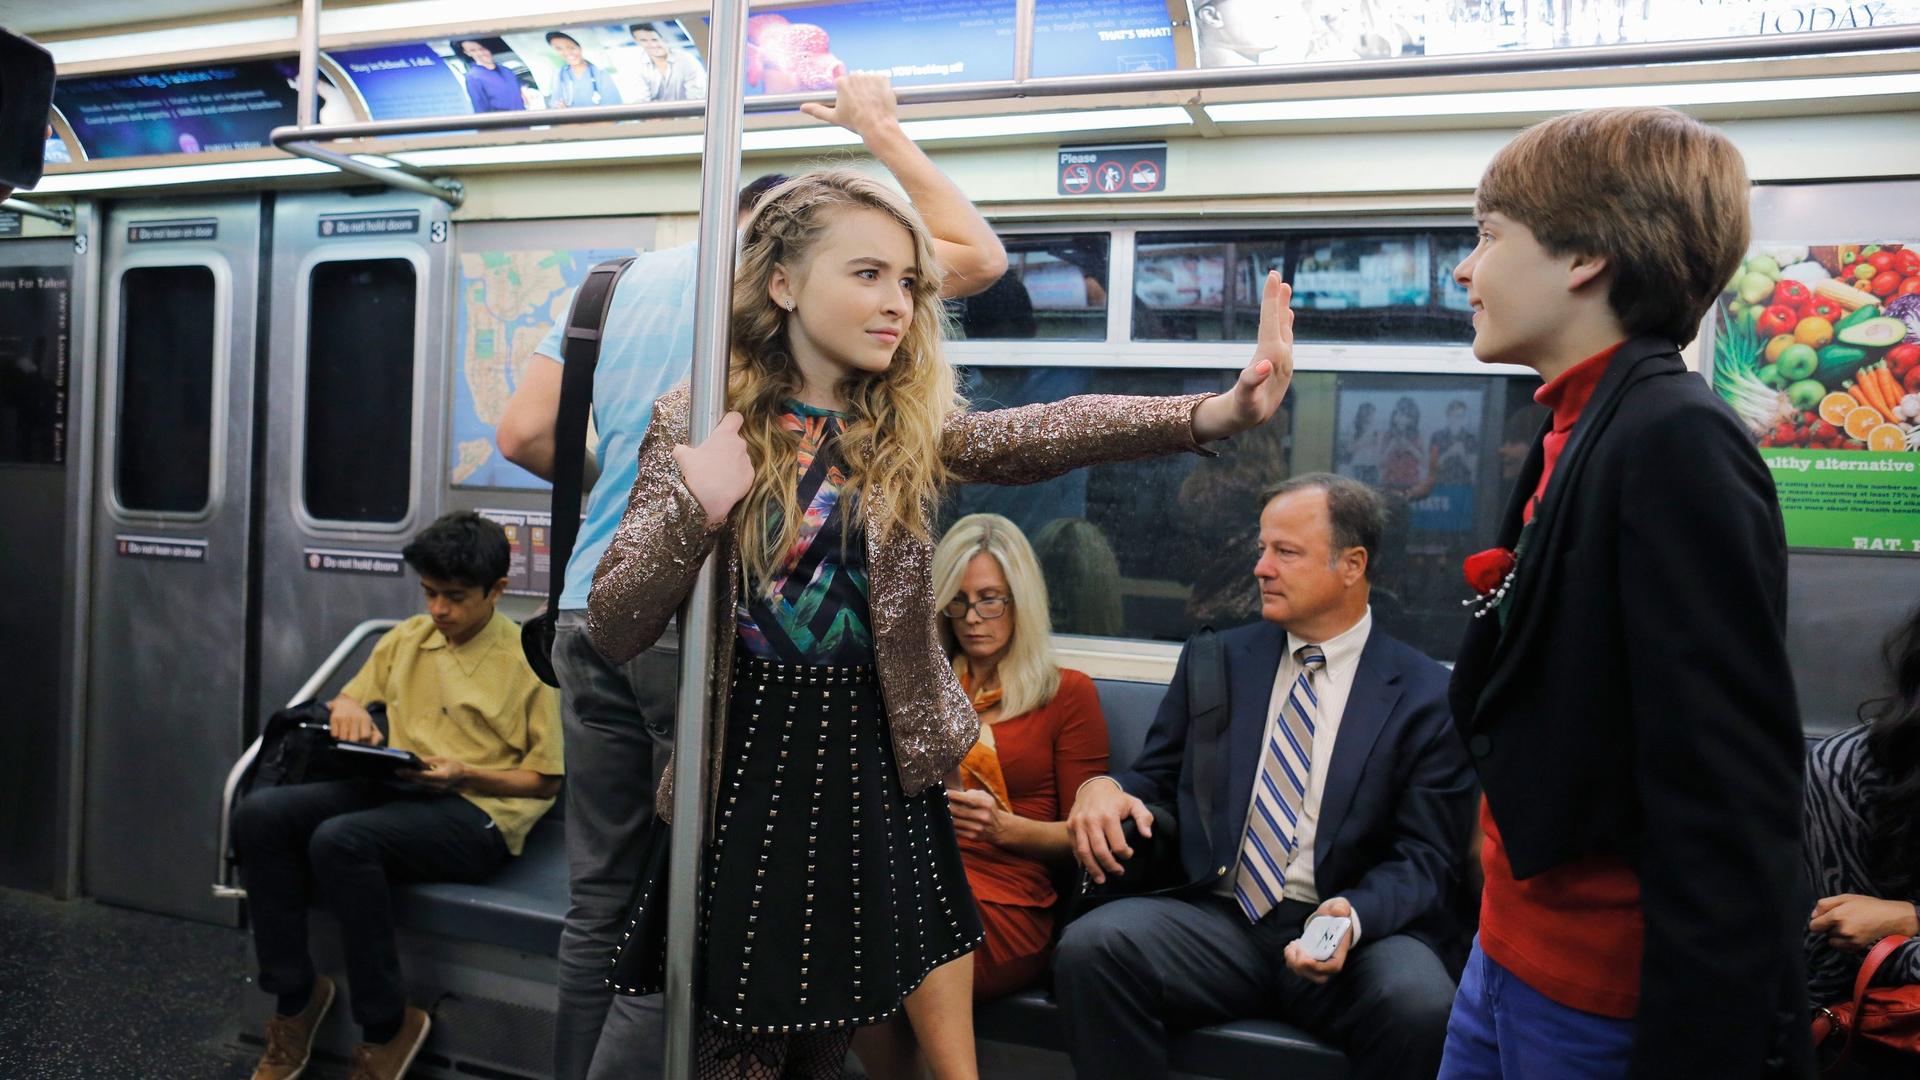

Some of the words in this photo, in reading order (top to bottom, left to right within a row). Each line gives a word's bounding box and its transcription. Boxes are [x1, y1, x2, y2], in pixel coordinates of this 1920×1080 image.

[1757, 3, 1886, 35] TODAY
[1097, 30, 1135, 41] THAT'S
[1135, 27, 1171, 39] WHAT!
[138, 75, 167, 89] Big
[1060, 153, 1097, 164] Please
[140, 228, 152, 240] Do
[153, 228, 164, 239] not
[195, 226, 213, 238] door
[336, 221, 350, 234] Do
[351, 221, 365, 233] not
[366, 219, 385, 232] hold
[386, 219, 413, 231] doors
[432, 221, 446, 243] 3
[75, 234, 87, 255] 3
[18, 277, 34, 289] For
[1766, 456, 1811, 472] althy
[1815, 458, 1915, 472] alternative
[1852, 537, 1907, 552] EAT.
[323, 556, 337, 568] Do
[337, 558, 352, 570] not
[352, 558, 373, 571] hold
[373, 560, 399, 573] doors
